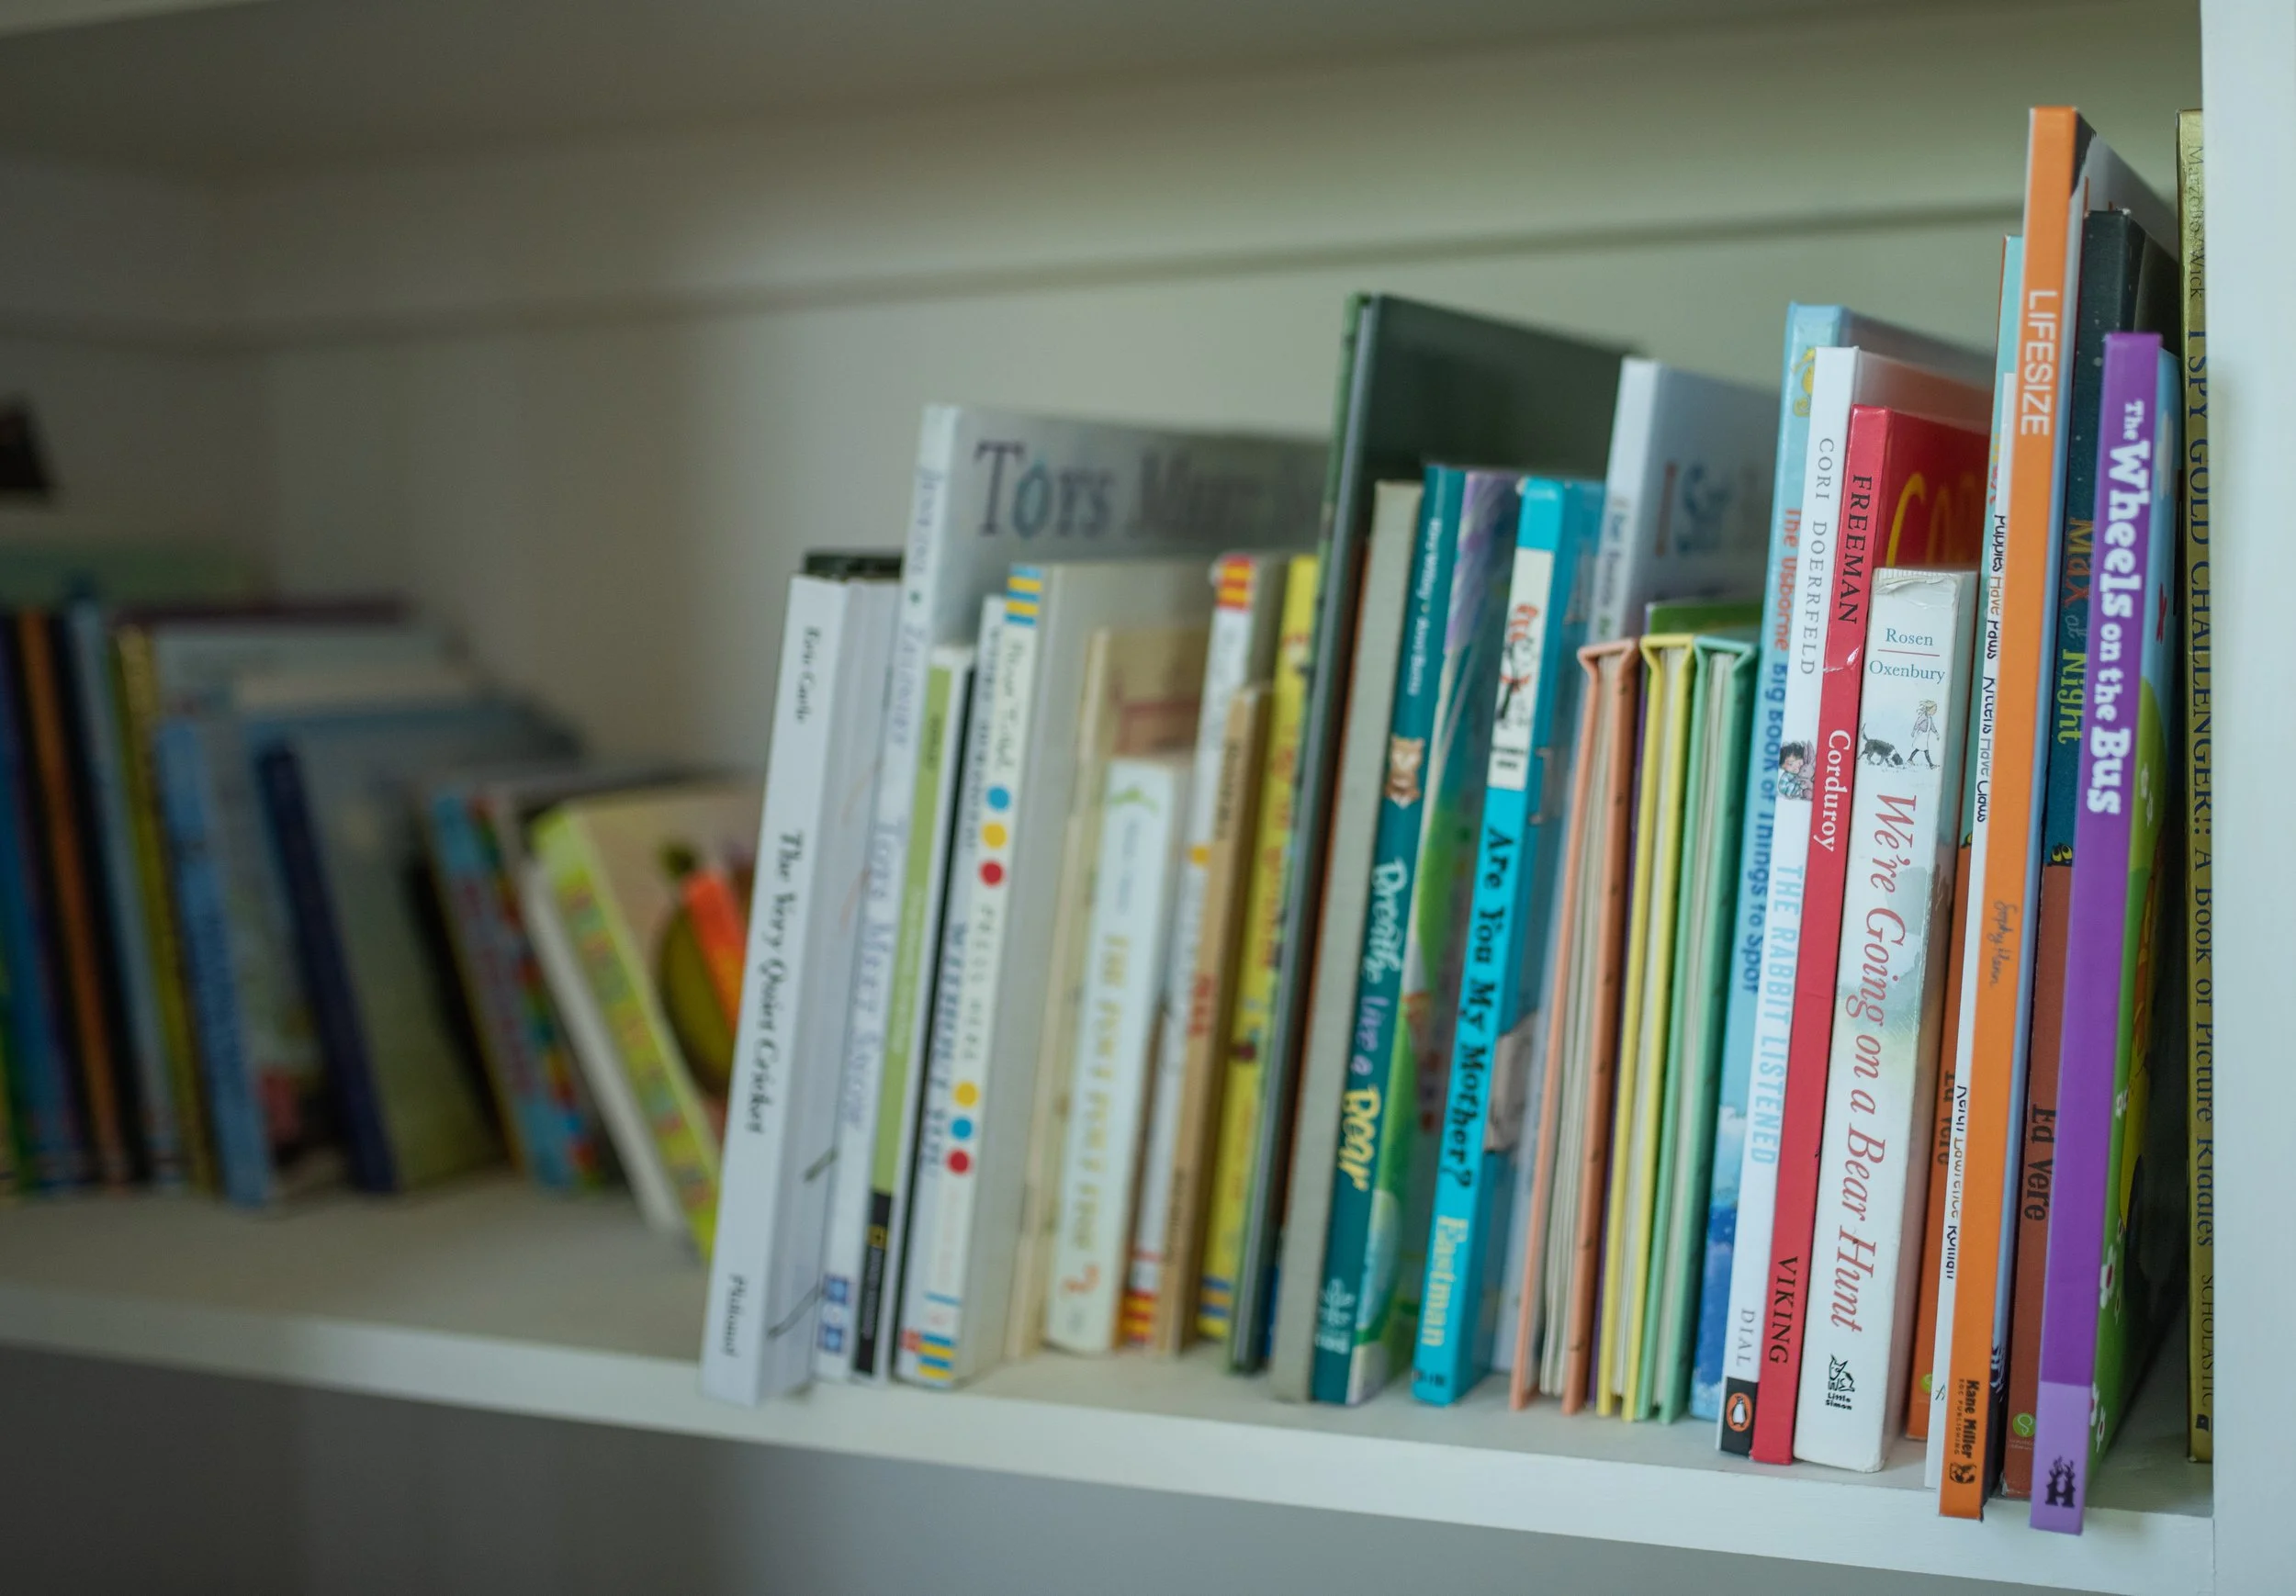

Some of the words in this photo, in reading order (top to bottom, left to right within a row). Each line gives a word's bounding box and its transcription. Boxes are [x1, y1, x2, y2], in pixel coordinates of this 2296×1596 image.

[2020, 289, 2059, 437] LIFESIZE
[2188, 330, 2206, 342] I
[2122, 399, 2145, 441] The
[2189, 357, 2209, 421] SPY
[1815, 437, 1836, 500] CORI
[2189, 438, 2210, 546] GOLD
[1837, 474, 1873, 625] FREEMAN
[2099, 441, 2150, 619] Wheels
[2063, 516, 2096, 610] Max
[1773, 555, 1797, 653] Usborne
[1798, 520, 1829, 676] DOERRFELD
[1885, 628, 1933, 646] Rosen
[2099, 623, 2122, 662] on
[1869, 660, 1946, 685] Oxenbury
[2056, 648, 2089, 746] Night
[2094, 668, 2125, 723] the
[1813, 729, 1851, 852] Corduroy
[2086, 725, 2133, 815] Bus
[776, 830, 804, 882] The
[1484, 828, 1514, 891] Are
[2194, 847, 2212, 872] A
[761, 893, 799, 950] Very
[1362, 858, 1409, 984] Breathe
[1772, 864, 1804, 915] THE
[1474, 906, 1506, 965] You
[2195, 886, 2213, 964] Book
[757, 958, 788, 1030] Quiet
[1763, 927, 1797, 1026] RABBIT
[1845, 906, 1907, 1028] Going
[1458, 980, 1497, 1032] My
[746, 1038, 781, 1134] Cricket
[1853, 1033, 1883, 1080] on
[1440, 1041, 1489, 1190] Mother?
[1751, 1036, 1789, 1165] LISTENED
[1850, 1088, 1877, 1115] a
[2031, 1103, 2057, 1144] Ed
[1336, 1085, 1382, 1192] Bear
[1841, 1122, 1886, 1222] Bear
[2024, 1158, 2054, 1222] Vere
[1422, 1215, 1470, 1348] Eastman
[1769, 1255, 1799, 1365] VIKING
[1831, 1224, 1877, 1333] Hunt
[1736, 1309, 1756, 1367] DIAL
[1825, 1399, 1853, 1411] Simon
[1828, 1392, 1851, 1403] Little
[1953, 1399, 1964, 1456] PUBLISHING
[1964, 1379, 1980, 1415] Kane
[1961, 1418, 1977, 1459] Miller
